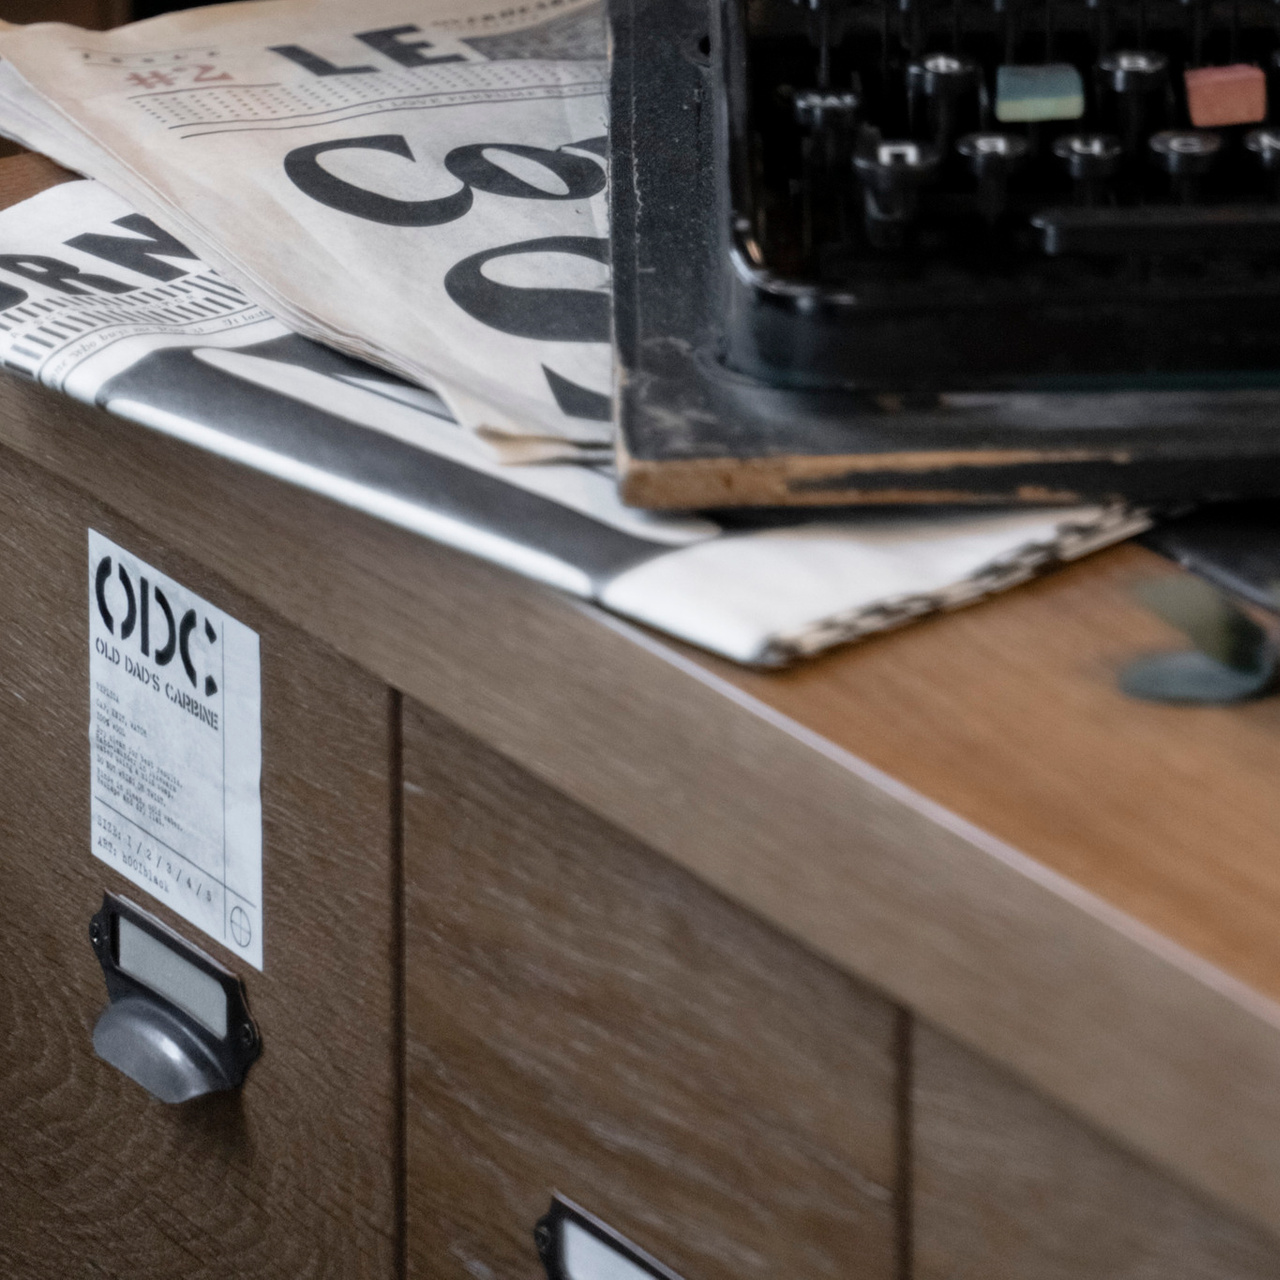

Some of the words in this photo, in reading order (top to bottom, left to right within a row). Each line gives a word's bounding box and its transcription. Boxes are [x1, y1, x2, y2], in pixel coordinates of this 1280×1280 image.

[95, 555, 218, 698] ODC
[95, 636, 120, 666] OLD
[124, 656, 160, 692] DAD'S
[165, 682, 219, 731] CARBINE
